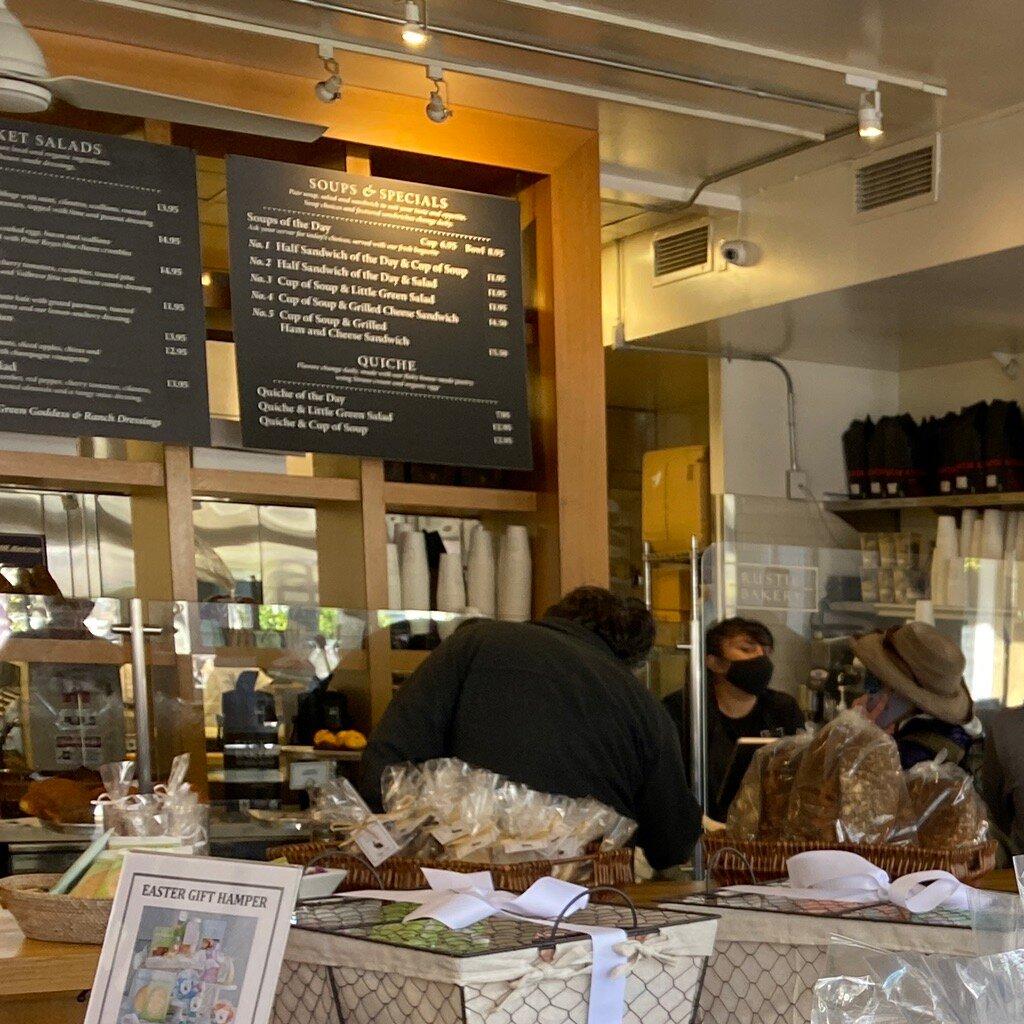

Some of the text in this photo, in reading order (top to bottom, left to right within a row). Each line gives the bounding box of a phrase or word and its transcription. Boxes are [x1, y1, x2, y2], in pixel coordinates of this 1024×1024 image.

[34, 135, 102, 156] SALADS
[309, 178, 358, 196] SOUPS
[362, 184, 377, 198] &
[379, 188, 449, 210] SPECIALS
[247, 211, 332, 235] Soups of the Day
[420, 237, 438, 250] Cup
[276, 242, 299, 254] Half
[301, 246, 348, 260] Sandwich
[349, 252, 362, 262] of
[361, 253, 378, 265] the
[379, 255, 400, 269] Day
[400, 259, 410, 269] &
[411, 260, 432, 274] Cup
[432, 263, 444, 274] of
[444, 265, 469, 279] Soup
[277, 258, 300, 271] Half
[301, 262, 349, 277] Sandwich
[350, 269, 362, 279] of
[362, 270, 379, 281] the
[380, 272, 401, 286] Day
[401, 275, 411, 286] &
[411, 276, 438, 289] Salad
[277, 275, 300, 290] Cup
[300, 278, 312, 289] of
[313, 280, 338, 295] Soup
[340, 284, 350, 294] &
[351, 284, 379, 297] Little
[378, 288, 408, 302] Green
[409, 292, 436, 305] Salad
[278, 292, 460, 324] Cup of Soup & Grilled Cheese Sandwich
[279, 309, 387, 332] Cup of Soup & Grilled
[280, 322, 410, 348] Ham and Cheese Sandwich
[357, 355, 417, 372] QUICHE
[257, 386, 346, 406] Quiche of the Day
[29, 406, 70, 419] Goddess
[84, 411, 115, 423] Ranch
[117, 414, 162, 429] Dressings
[258, 401, 393, 423] Quiche & Little Green Salad
[259, 415, 369, 437] Quiche & Cup of Soup
[141, 884, 268, 909] EASTER GIFT HAMPER
